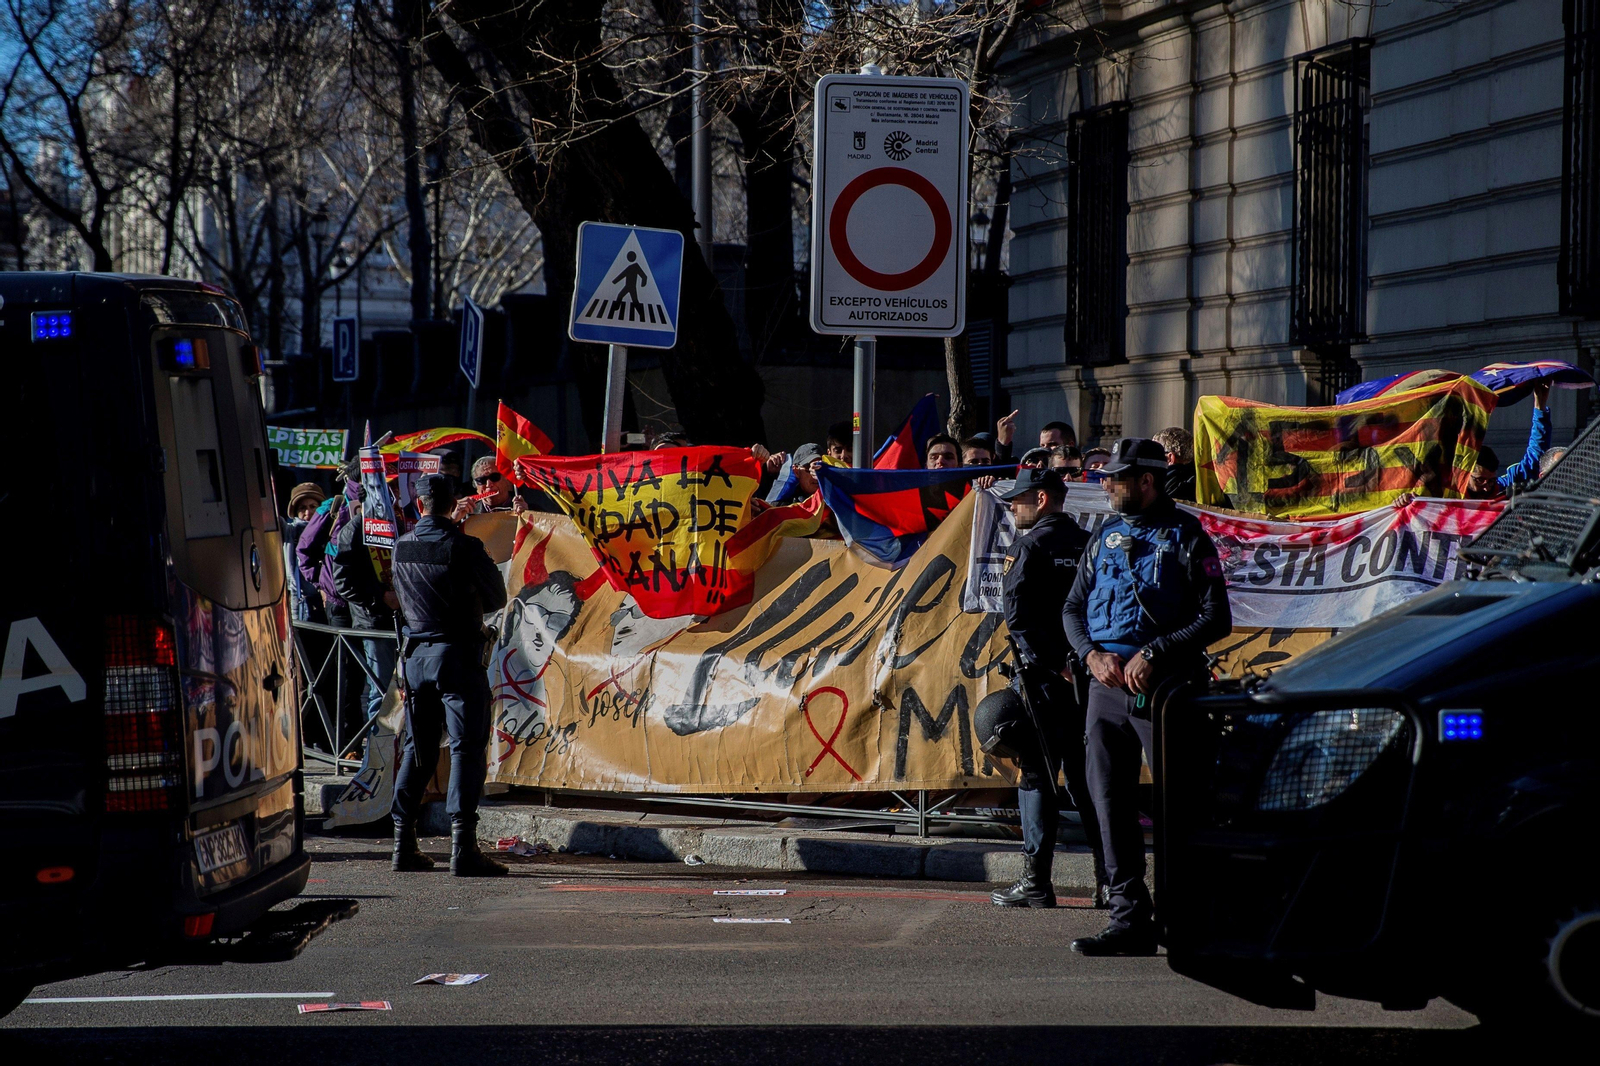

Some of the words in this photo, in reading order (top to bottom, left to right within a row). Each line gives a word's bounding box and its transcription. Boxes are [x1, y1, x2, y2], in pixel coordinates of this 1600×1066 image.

[852, 90, 882, 98] CAPTACIÓN
[892, 91, 919, 99] IMÁGENES
[928, 92, 958, 100] VEHÍCULOS
[915, 139, 939, 147] Madrid
[829, 296, 882, 307] EXCEPTO
[884, 296, 948, 309] VEHÍCULOS
[848, 310, 928, 322] AUTORIZADOS
[464, 308, 476, 365] P
[338, 323, 350, 372] P
[268, 429, 342, 447] LPISTAS
[271, 446, 340, 465] RISIÓN
[676, 454, 733, 489] LA
[687, 498, 743, 537] DE
[193, 707, 297, 799] POLIC
